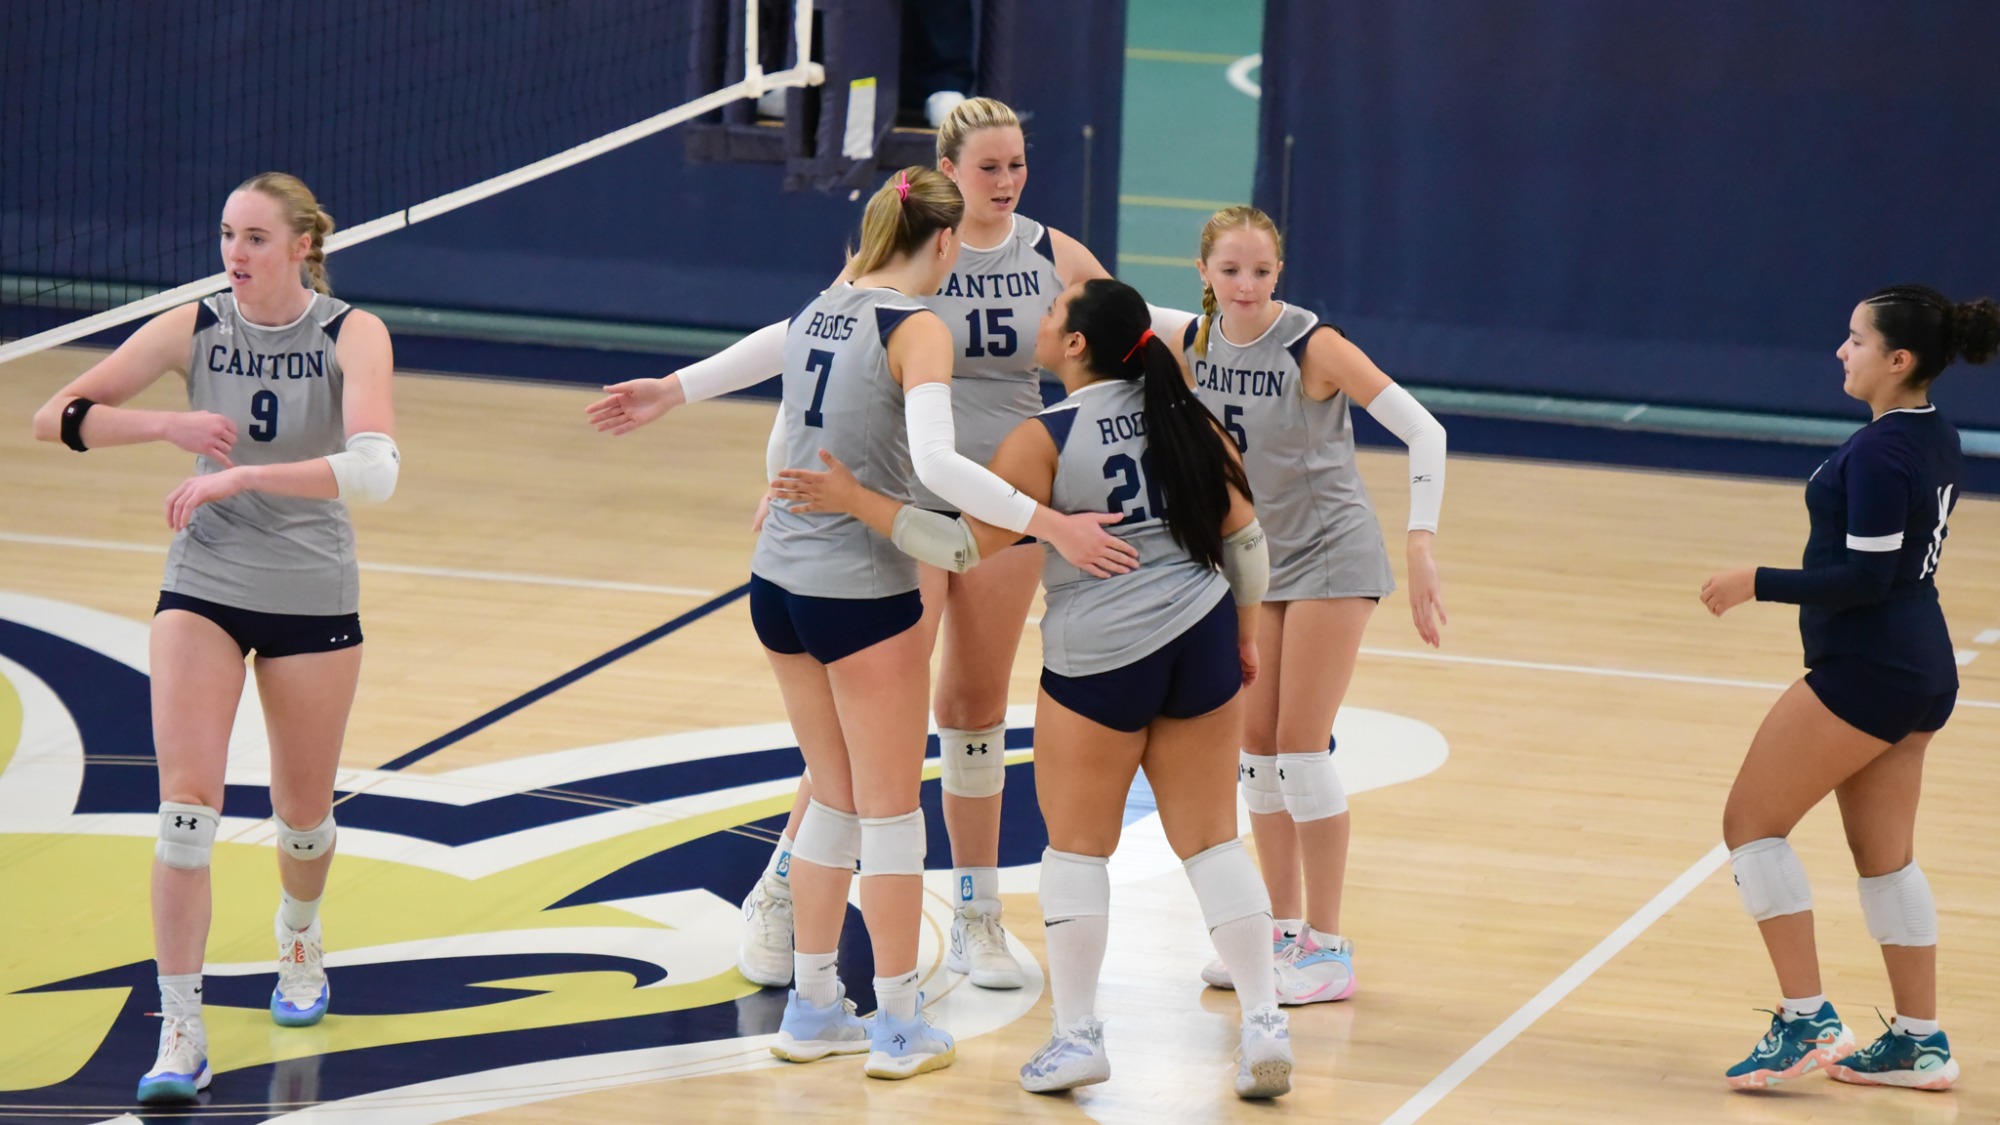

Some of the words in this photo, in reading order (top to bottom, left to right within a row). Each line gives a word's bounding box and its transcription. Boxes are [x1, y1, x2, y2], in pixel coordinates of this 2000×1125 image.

[936, 270, 1040, 298] ANTON
[805, 311, 858, 341] ROOS
[965, 308, 1018, 358] 15
[208, 344, 324, 380] CANTON
[1195, 360, 1285, 397] CANTON
[804, 348, 836, 429] 7
[248, 389, 279, 442] 9
[1096, 411, 1147, 445] ROO
[1224, 404, 1248, 454] 5
